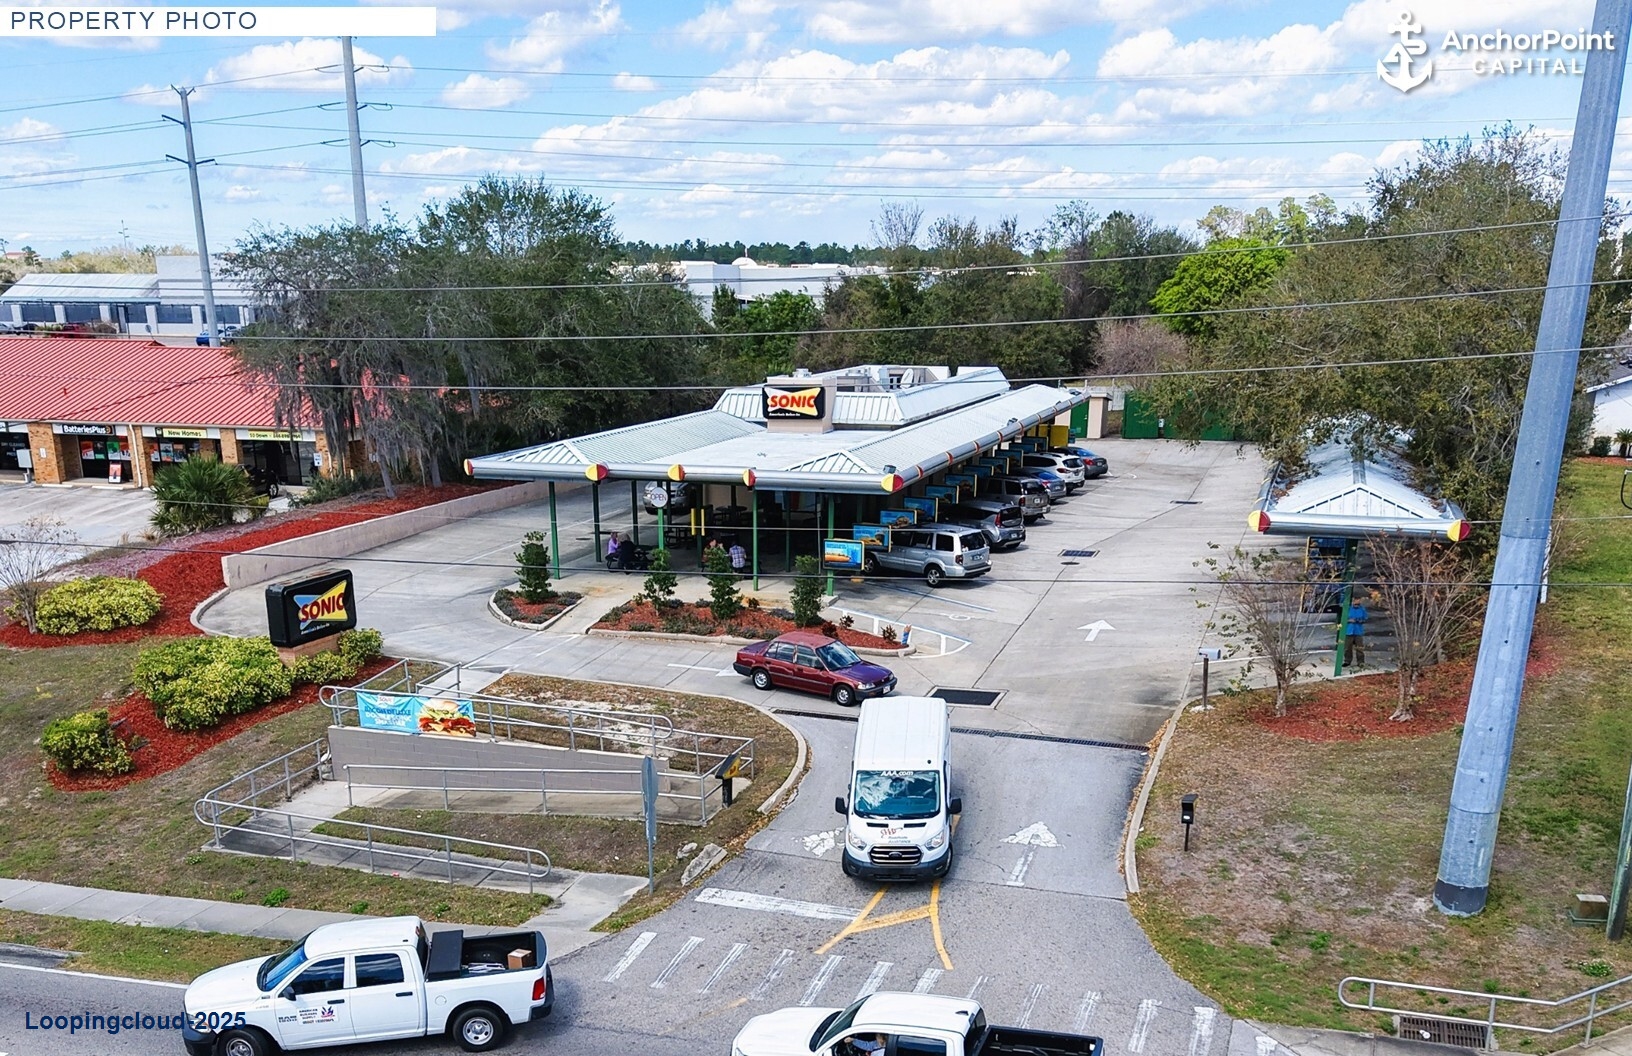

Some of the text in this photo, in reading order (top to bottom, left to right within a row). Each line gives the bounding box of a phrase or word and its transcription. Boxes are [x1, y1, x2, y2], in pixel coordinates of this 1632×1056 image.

[770, 395, 816, 408] SONIC
[63, 425, 106, 434] BatteriesPlus
[651, 493, 667, 501] OPEN
[301, 592, 345, 623] SONIC
